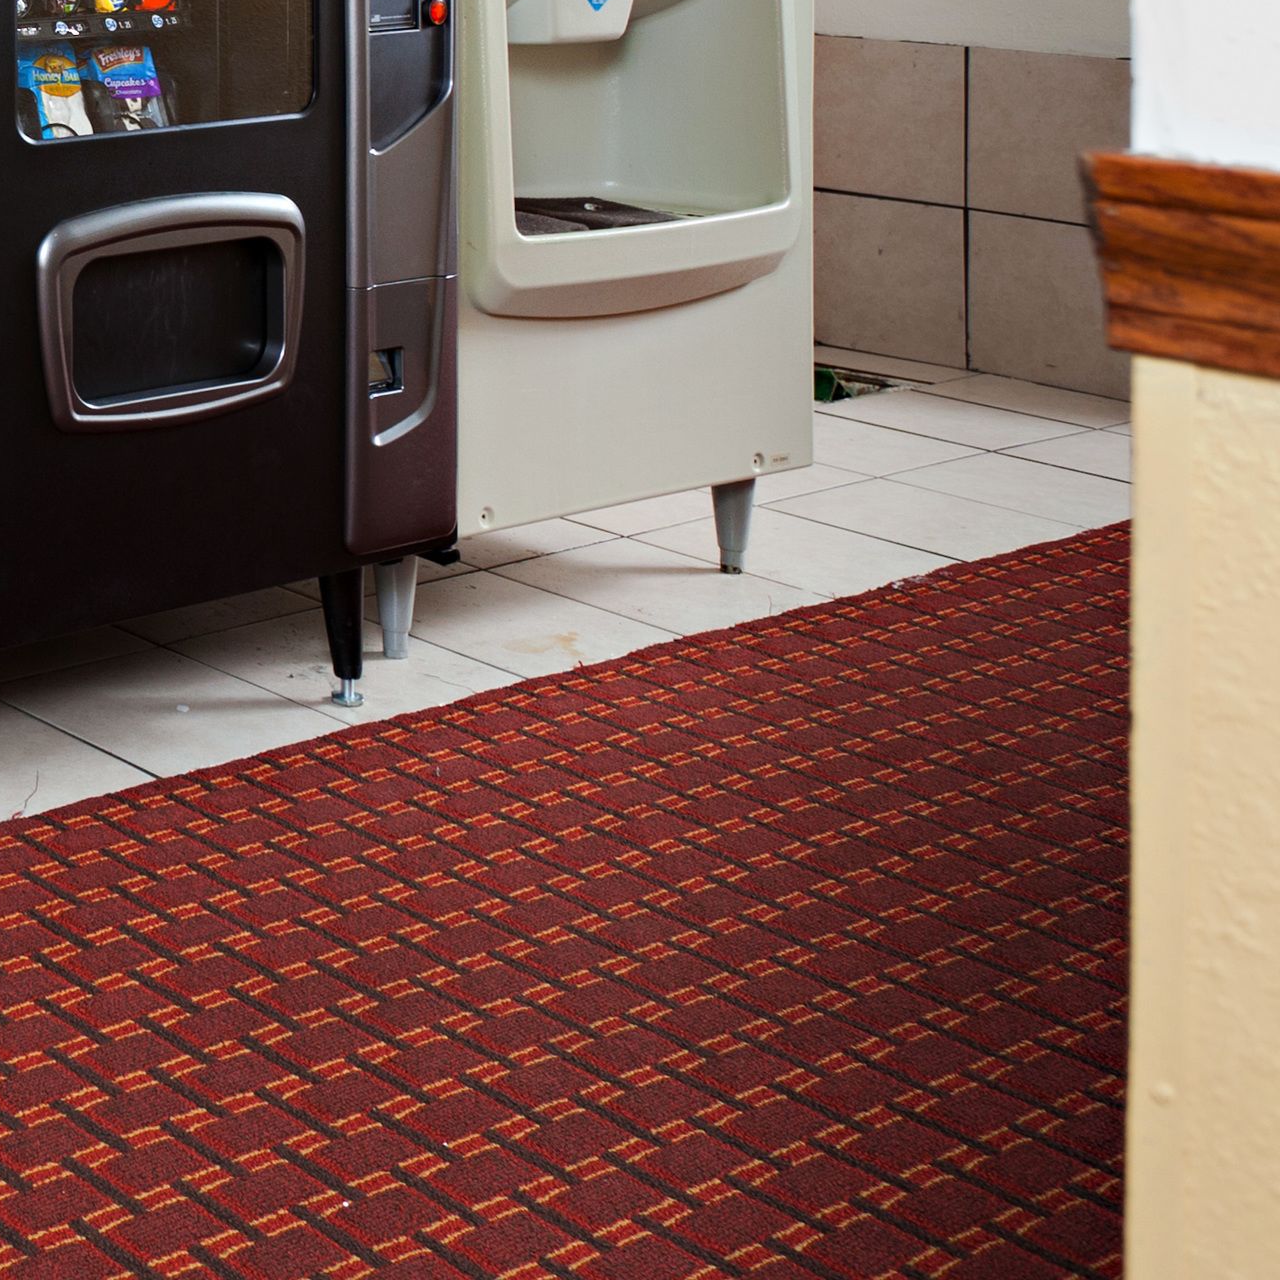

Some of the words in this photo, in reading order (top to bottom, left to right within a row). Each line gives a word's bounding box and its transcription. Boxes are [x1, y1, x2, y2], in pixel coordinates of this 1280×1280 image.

[98, 48, 141, 66] Freshley's
[32, 70, 62, 86] Honey
[104, 77, 146, 88] Cupcakes
